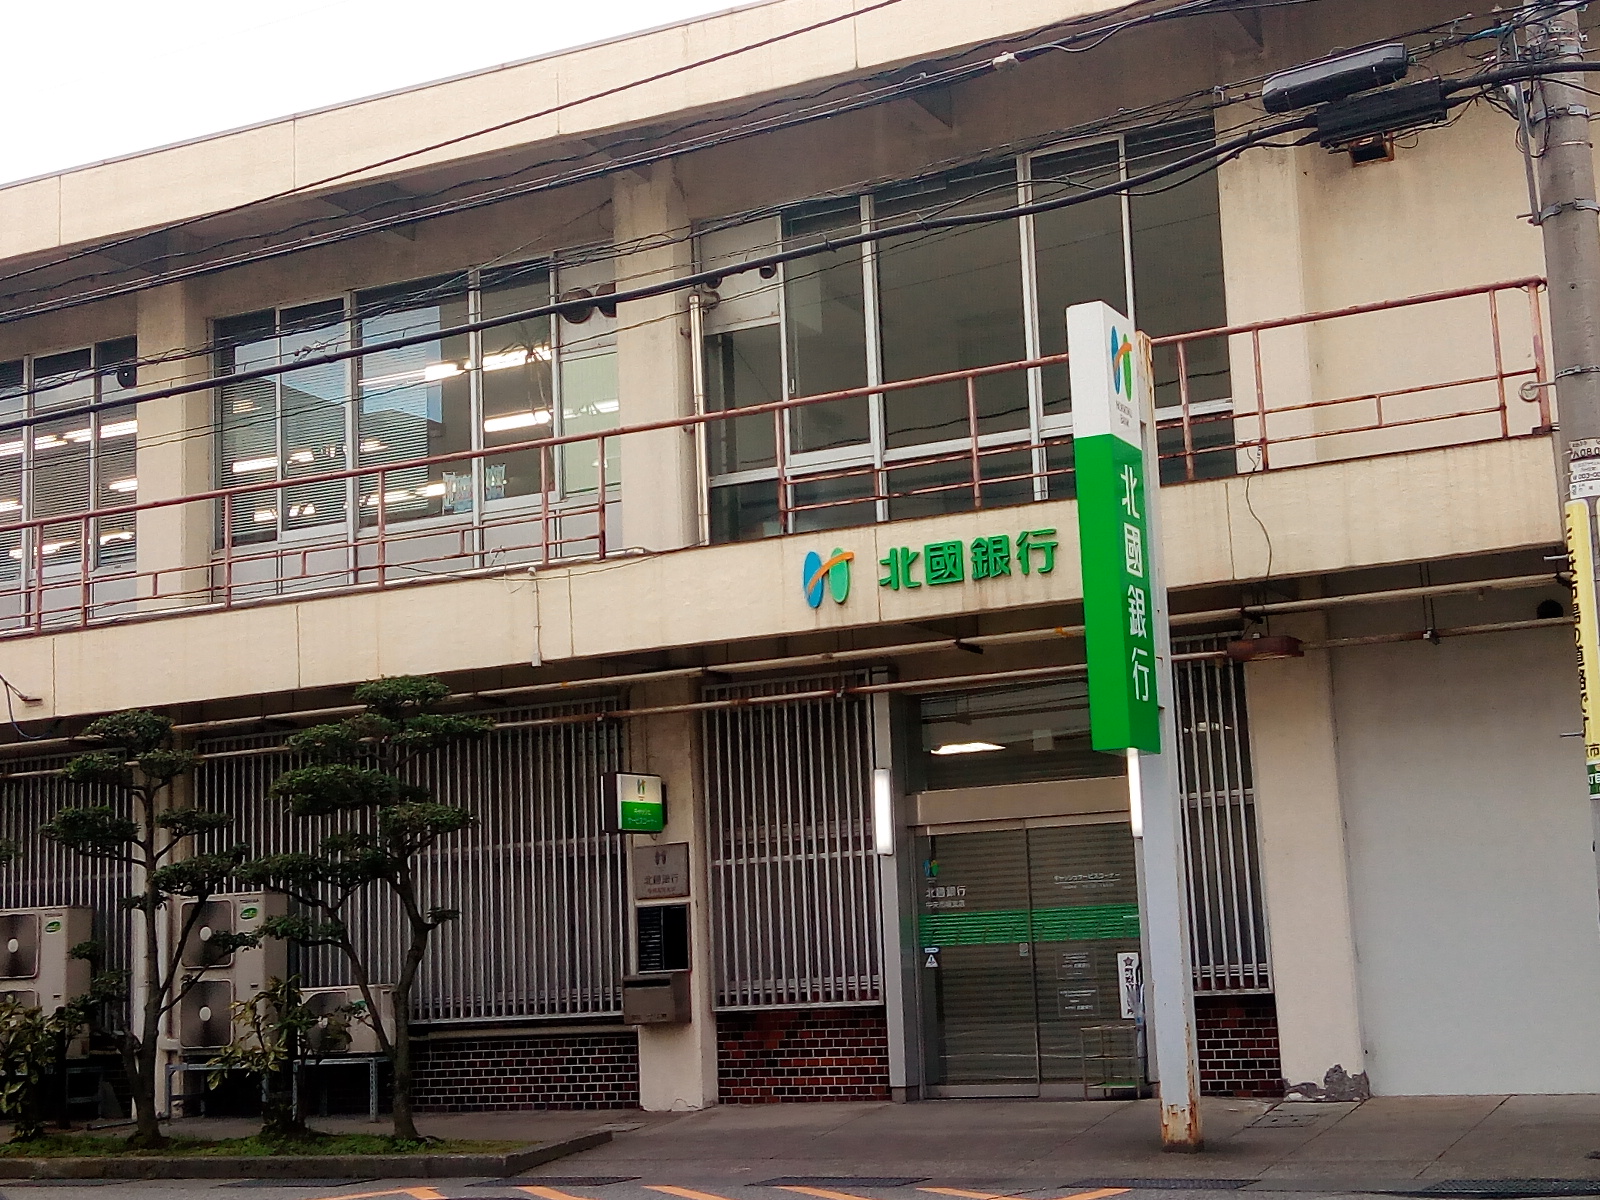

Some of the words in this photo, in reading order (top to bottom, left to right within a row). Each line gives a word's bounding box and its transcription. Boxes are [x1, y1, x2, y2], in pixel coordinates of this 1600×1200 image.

[879, 528, 1058, 590] 北國銀行
[1120, 464, 1150, 702] 北國銀行
